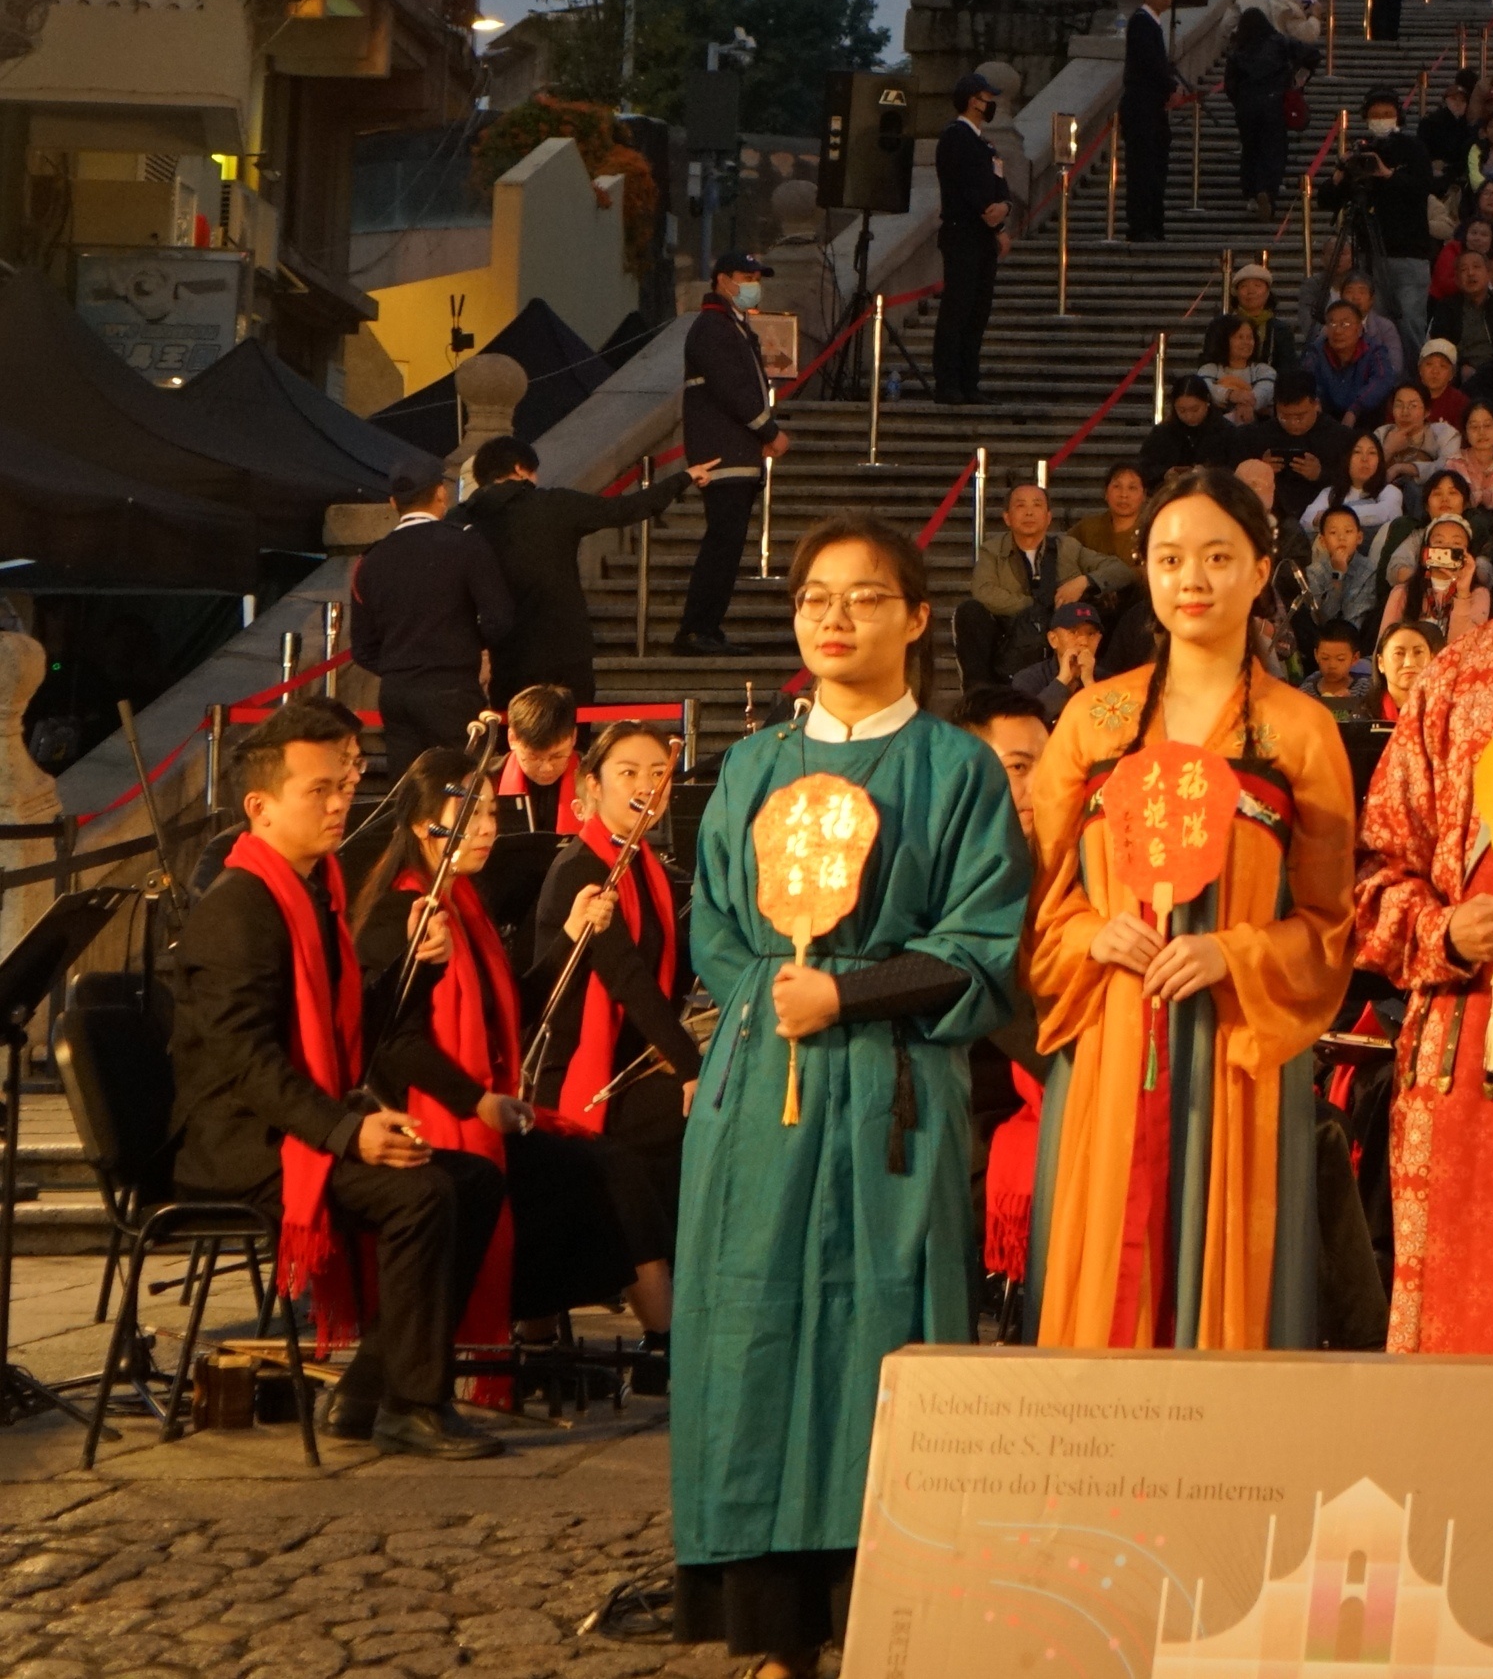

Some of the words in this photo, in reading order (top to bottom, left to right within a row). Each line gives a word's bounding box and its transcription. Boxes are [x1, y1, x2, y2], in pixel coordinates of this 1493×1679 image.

[912, 1392, 1012, 1419] Melodias
[1168, 1404, 1206, 1422] nas
[990, 1432, 1016, 1456] de
[1021, 1435, 1042, 1457] S.
[1048, 1434, 1116, 1459] Paulo:
[903, 1469, 1004, 1496] Concerto
[1009, 1472, 1037, 1497] do
[1043, 1472, 1126, 1500] Festival
[1131, 1476, 1169, 1501] das
[1175, 1476, 1286, 1504] Lanternas
